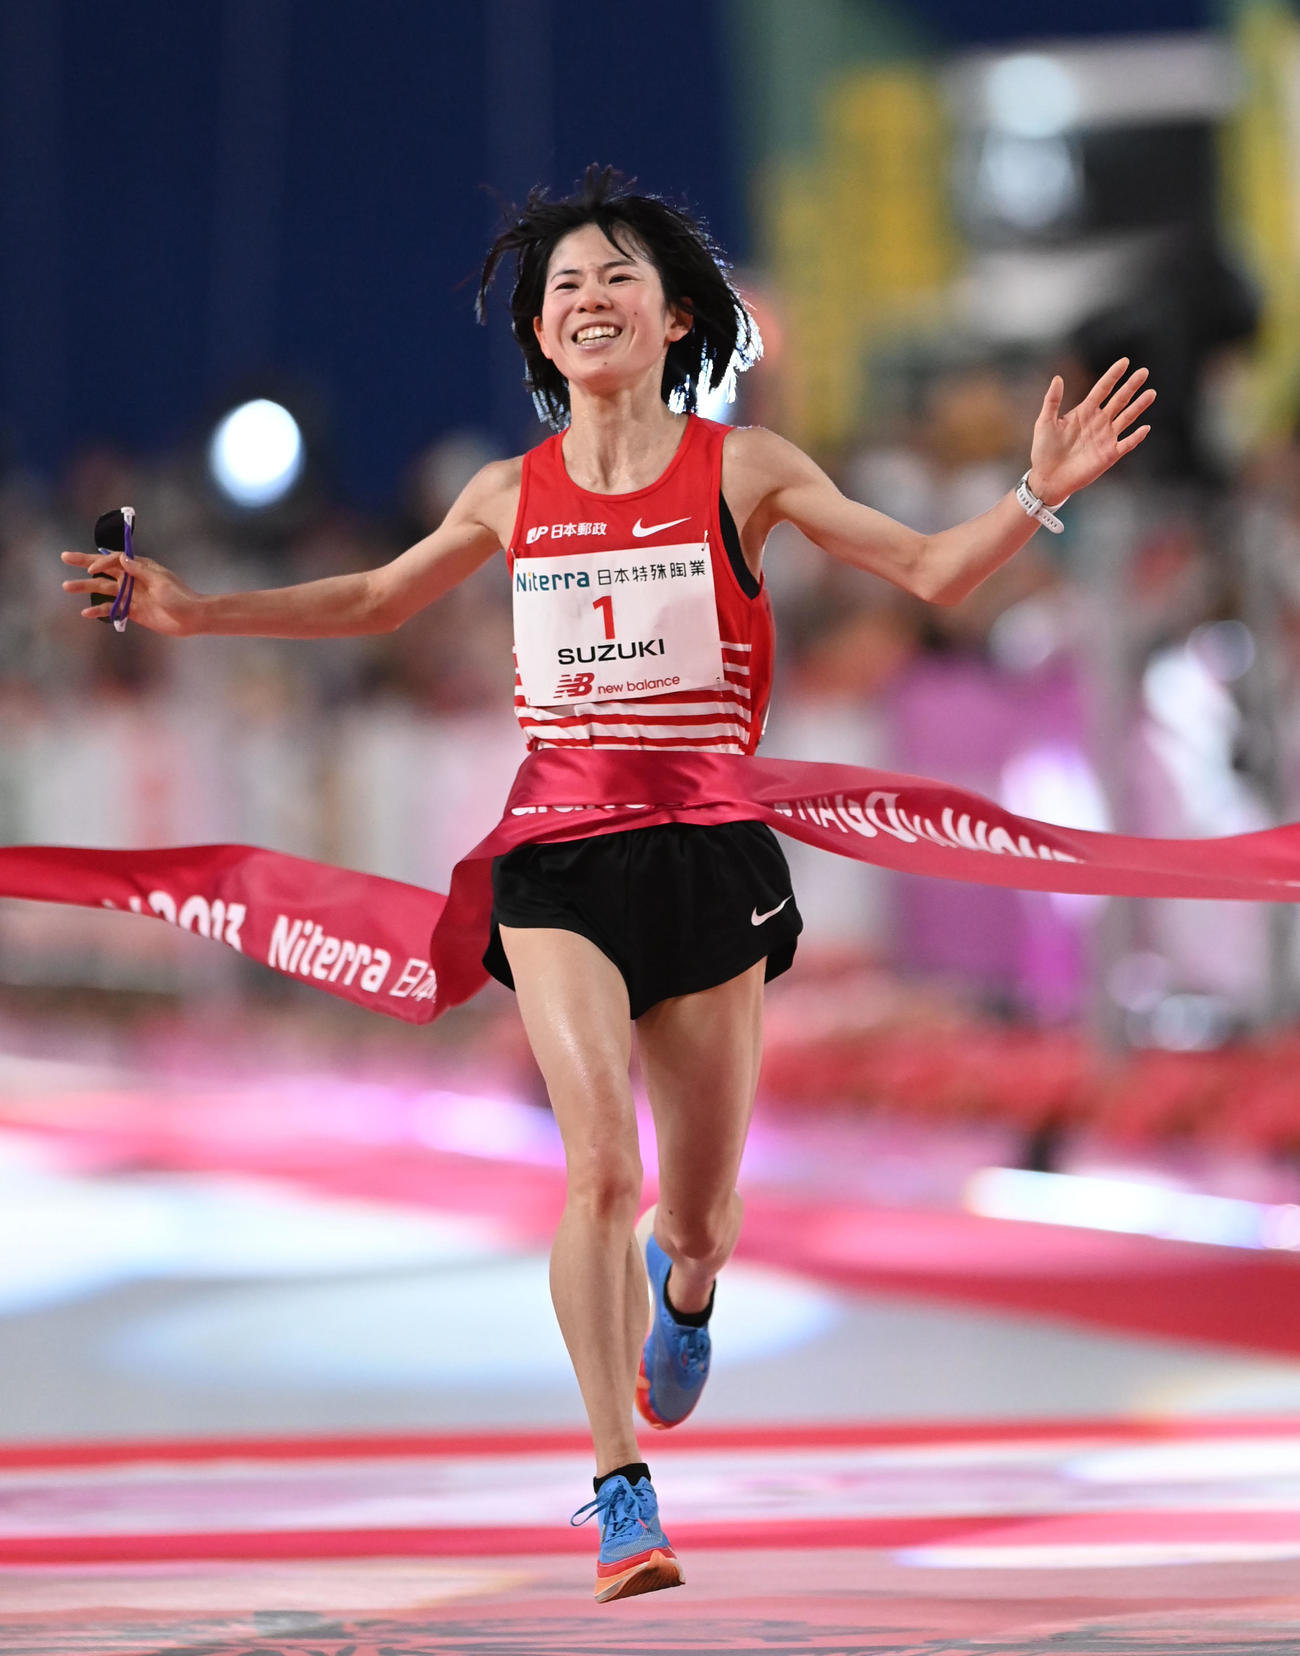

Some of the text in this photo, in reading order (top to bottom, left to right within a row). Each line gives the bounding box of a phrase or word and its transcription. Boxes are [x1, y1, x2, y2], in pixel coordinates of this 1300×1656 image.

[551, 522, 607, 539] 日本郵政
[516, 559, 706, 592] Niterra 日本特殊陶業
[592, 595, 616, 640] 1
[557, 638, 665, 665] SUZUKI
[597, 684, 624, 695] new
[627, 676, 681, 692] balance
[268, 914, 392, 993] Niterra
